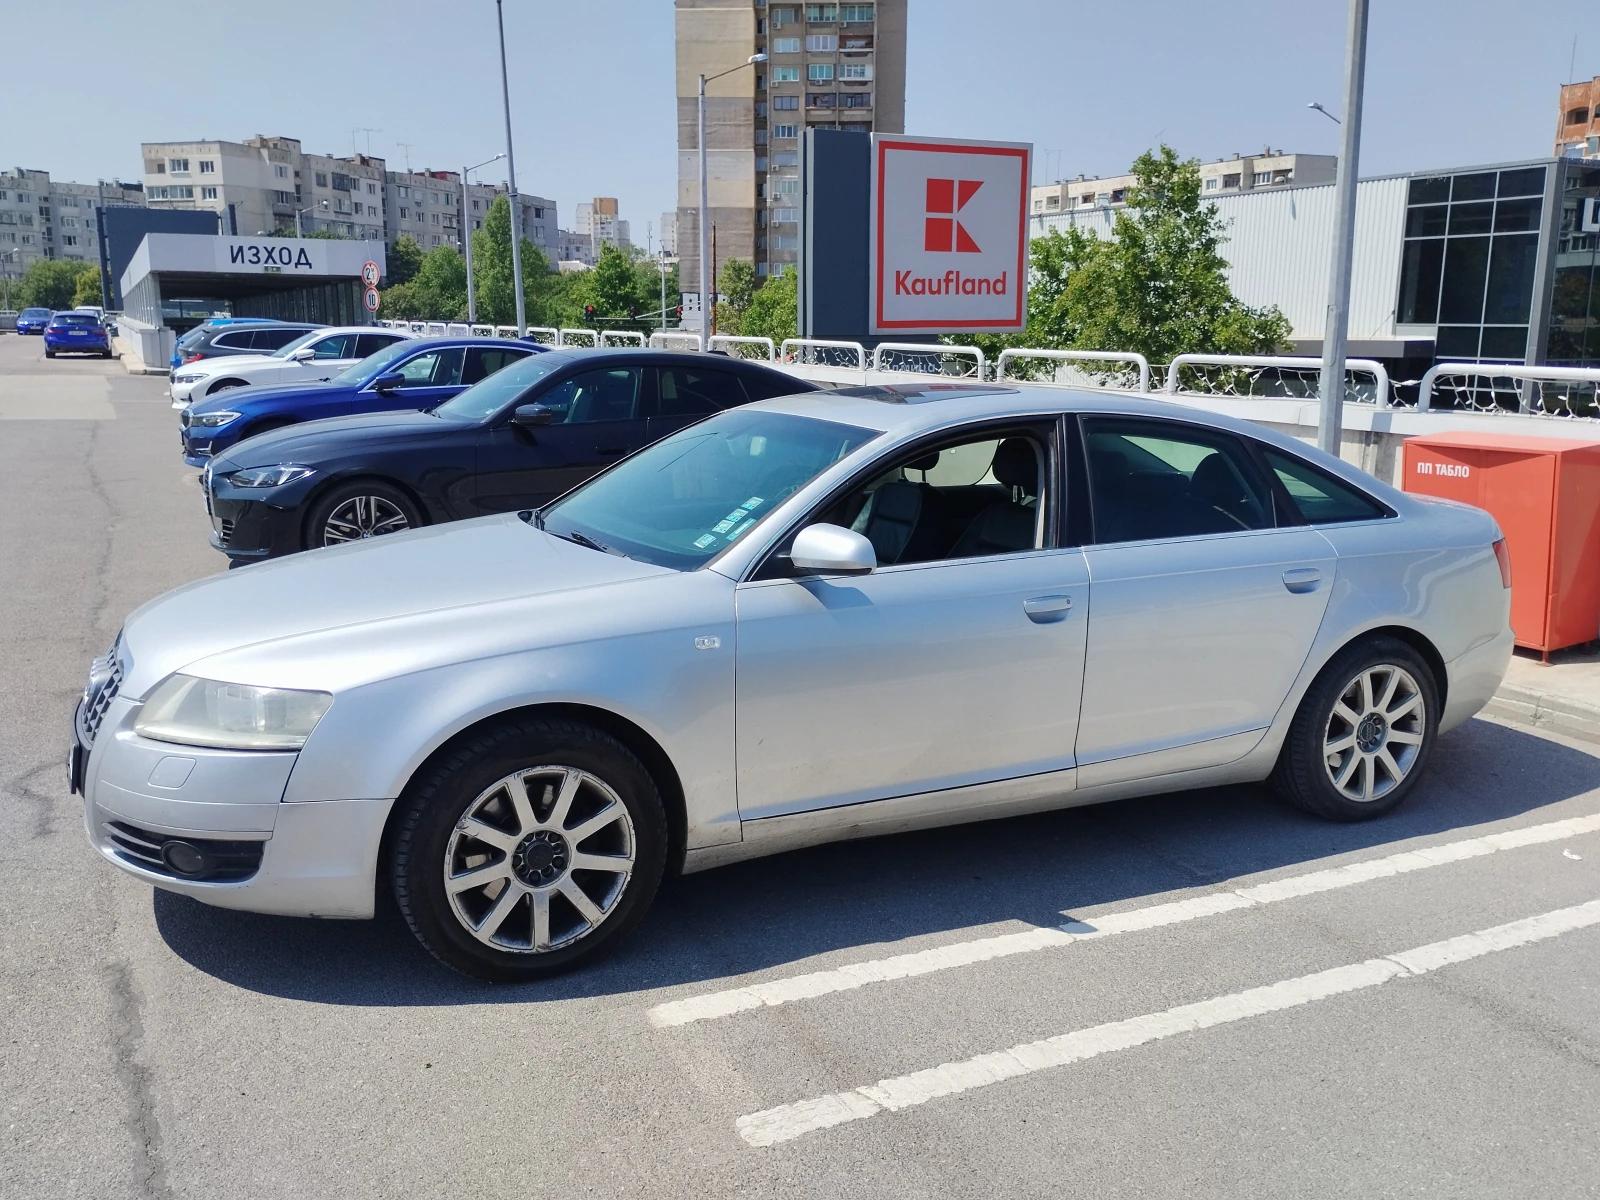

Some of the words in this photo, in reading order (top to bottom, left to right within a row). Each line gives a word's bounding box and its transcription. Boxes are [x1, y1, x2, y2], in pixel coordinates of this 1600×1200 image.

[230, 245, 312, 269] ИЗХОД
[895, 270, 1007, 295] Kaufland
[368, 294, 376, 306] 10
[1417, 462, 1433, 475] ПП
[1434, 463, 1470, 478] ТАБЛО
